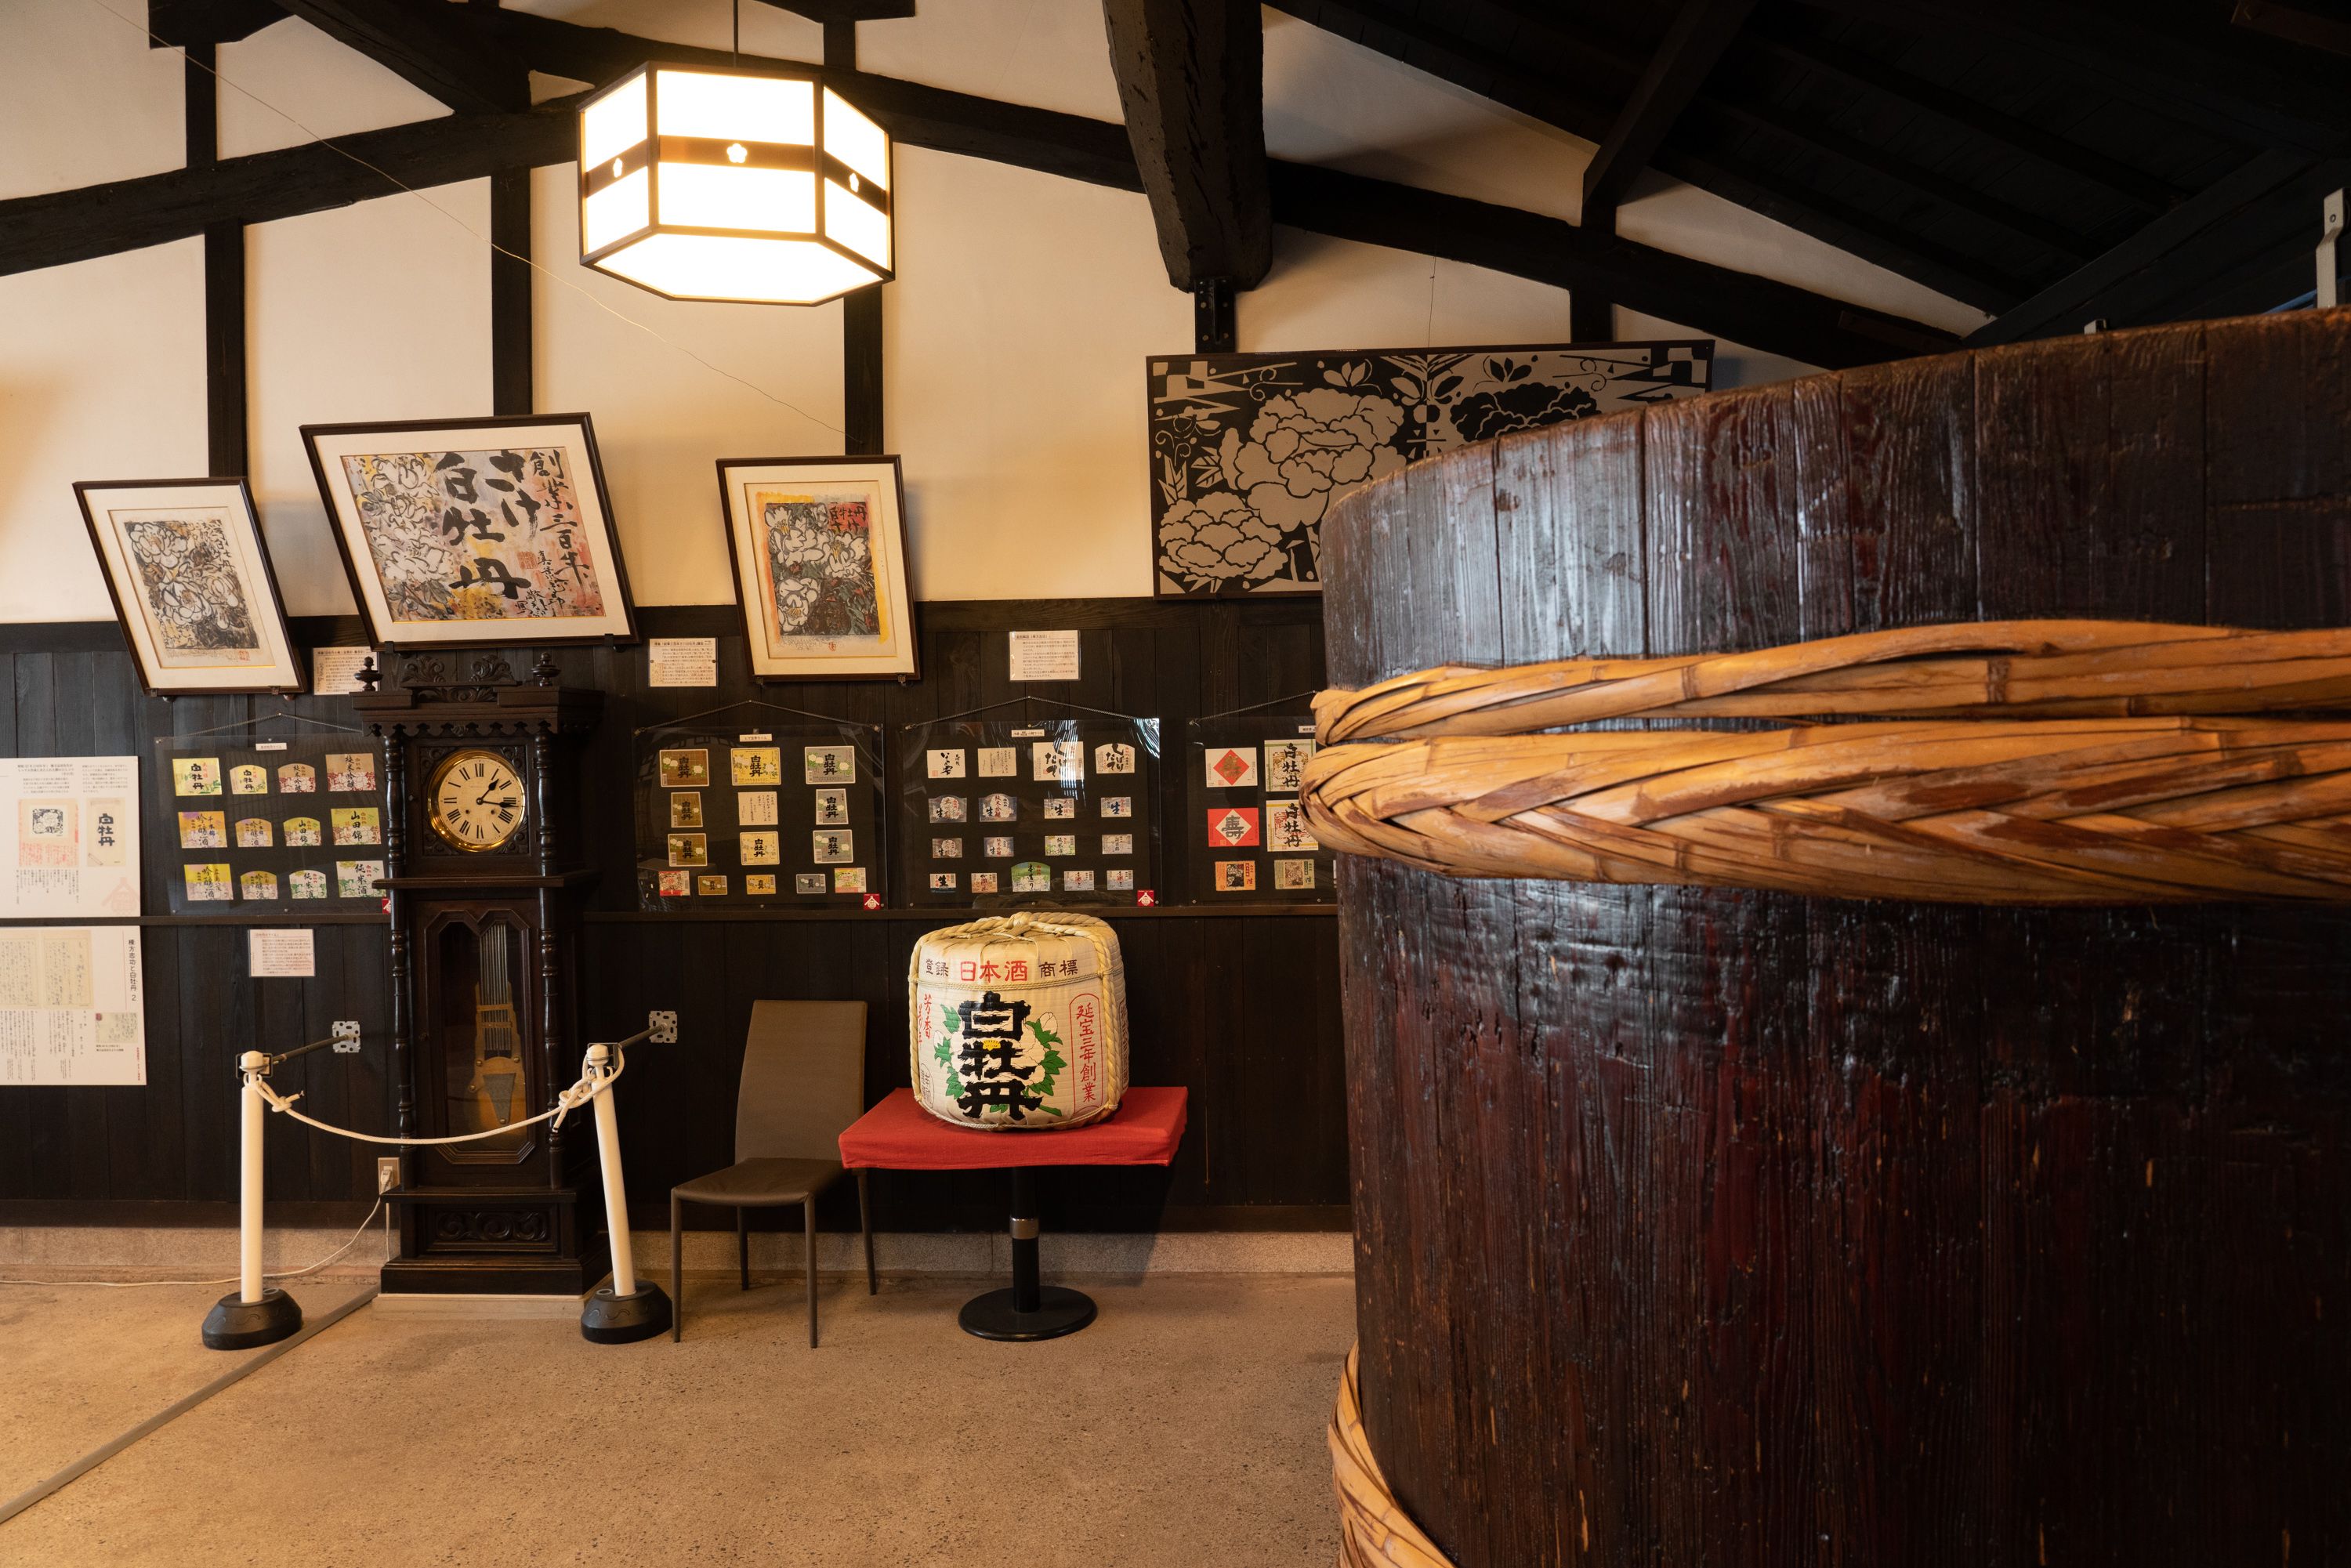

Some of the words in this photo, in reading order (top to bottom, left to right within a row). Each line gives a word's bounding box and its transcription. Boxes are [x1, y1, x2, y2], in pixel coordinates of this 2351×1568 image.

[435, 451, 531, 600] 白牡丹
[531, 449, 590, 587] 創業三百年
[191, 763, 205, 790] 白牡丹
[345, 755, 357, 788] 純米吟醸
[678, 756, 691, 779] 白牡丹
[749, 755, 763, 777] 白牡丹
[824, 754, 838, 776] 白牡丹
[1282, 743, 1301, 788] 白牡丹
[243, 770, 254, 790] 白牡丹
[681, 801, 693, 820] 白牡丹
[825, 797, 839, 819] 白牡丹
[936, 808, 944, 818] 生
[987, 806, 994, 817] 生
[1055, 804, 1063, 816] 生
[1110, 802, 1121, 815] 生
[97, 813, 115, 847] 白牡丹
[196, 813, 209, 846] 吟醸酒
[299, 820, 308, 843] 山田錦
[351, 811, 363, 842] 山田錦
[1284, 802, 1302, 848] 白牡丹
[683, 840, 694, 860] 白牡丹
[753, 838, 766, 858] 白牡丹
[828, 837, 839, 856] 白牡丹
[355, 864, 368, 895] 純米酒
[128, 939, 138, 992] 棟方志功と白牡丹
[925, 958, 949, 977] 登録
[960, 961, 1028, 983] 日本酒
[1039, 959, 1078, 978] 商標
[957, 990, 1044, 1121] 白牡丹
[1076, 1001, 1097, 1103] 延宝三年創業
